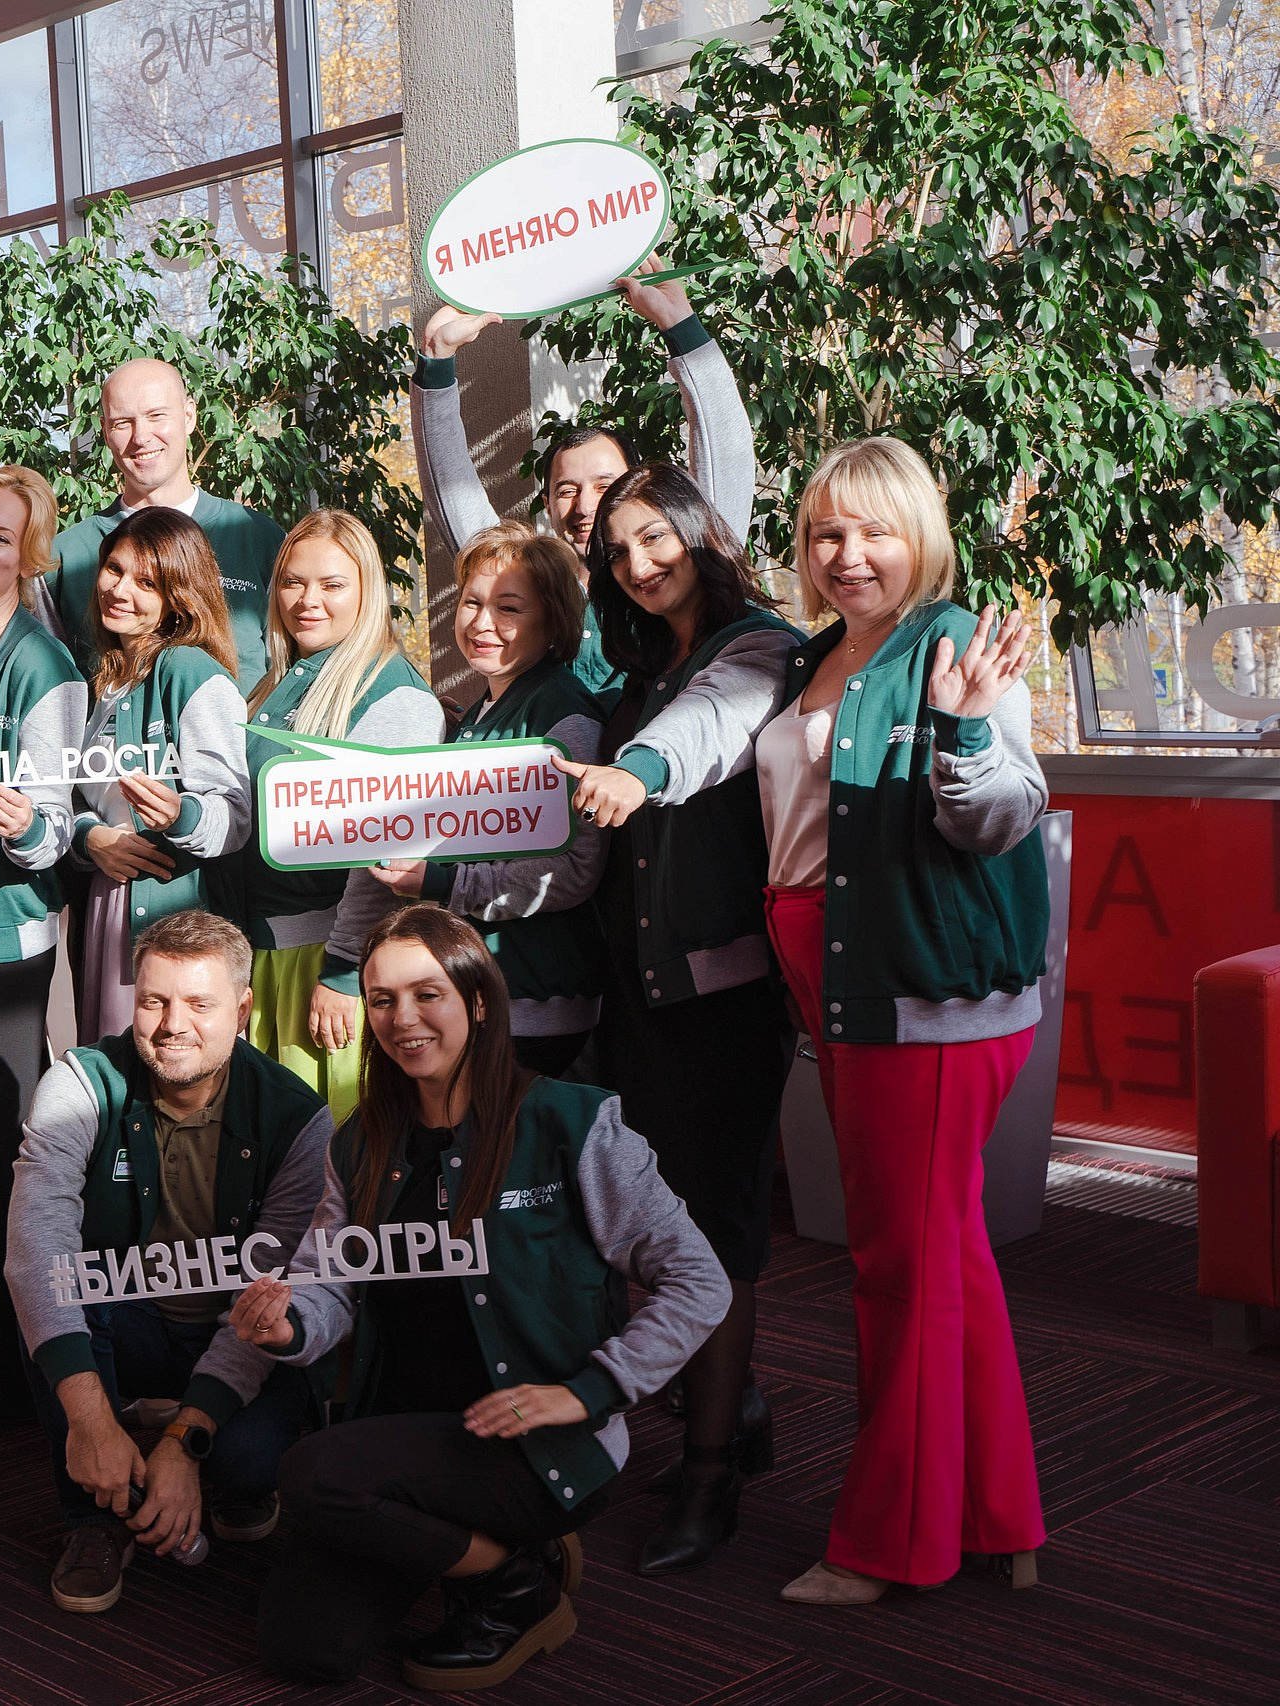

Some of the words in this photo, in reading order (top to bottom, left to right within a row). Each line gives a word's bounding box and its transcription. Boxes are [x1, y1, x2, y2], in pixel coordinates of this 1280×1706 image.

[434, 245, 455, 275] Я
[463, 207, 580, 268] МЕНЯЮ
[588, 181, 658, 229] МИР
[273, 764, 560, 809] ПРЕДПРИНИМАТЕЛЬ
[292, 818, 335, 847] НА
[342, 811, 415, 844] ВСЮ
[424, 804, 543, 839] ГОЛОВУ
[520, 1180, 563, 1199] ФОРМУЛ
